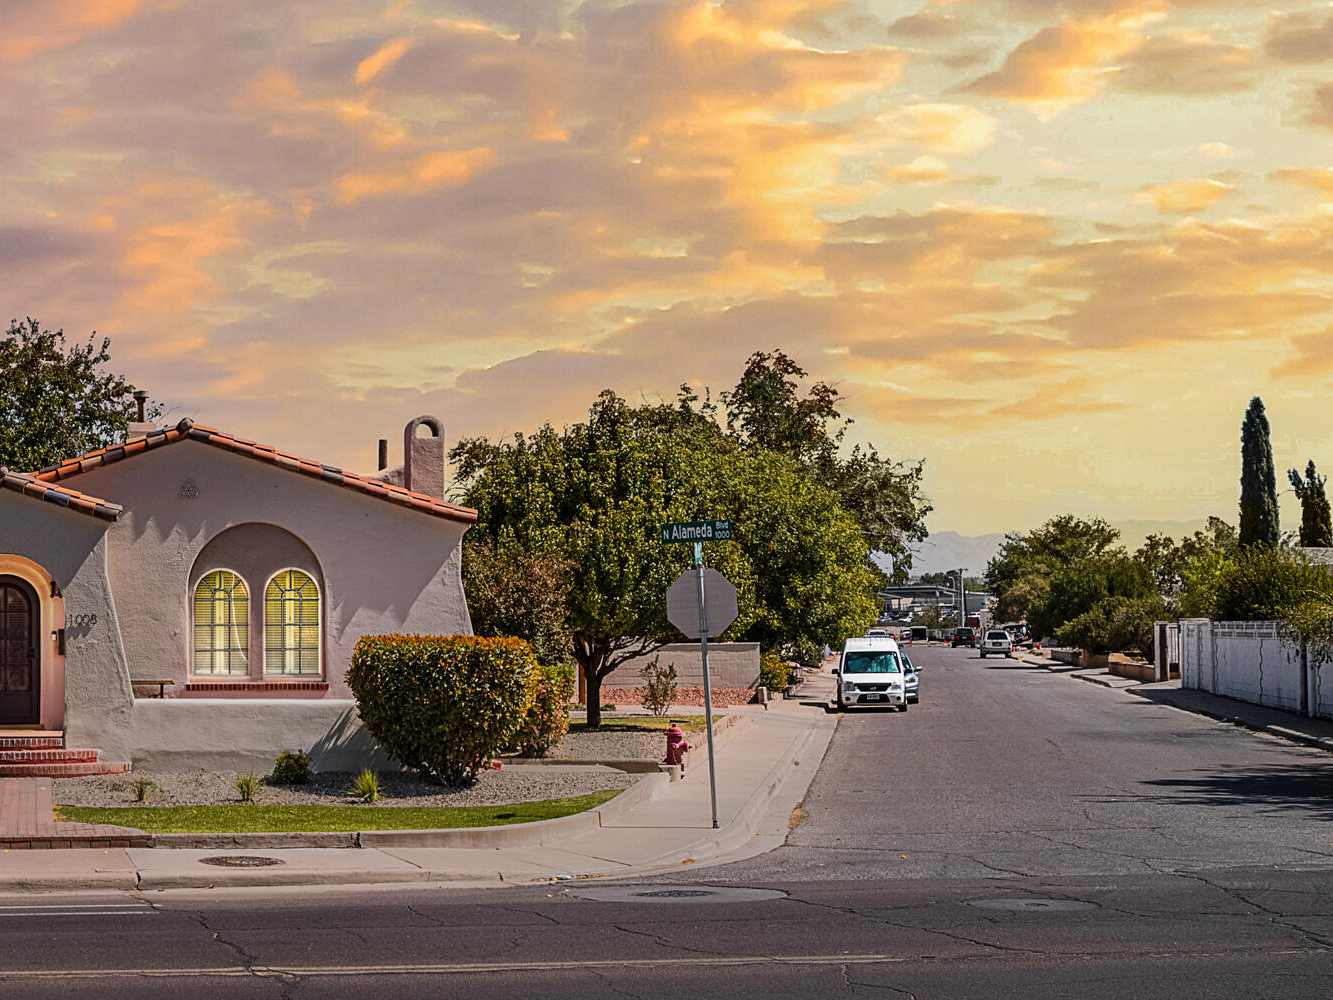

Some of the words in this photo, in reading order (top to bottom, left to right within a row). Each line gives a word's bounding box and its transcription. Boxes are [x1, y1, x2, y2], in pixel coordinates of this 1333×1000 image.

[715, 521, 729, 529] Blvd
[663, 529, 670, 540] N
[671, 523, 713, 540] Alameda
[714, 530, 730, 539] 1000
[69, 614, 97, 625] 1008
